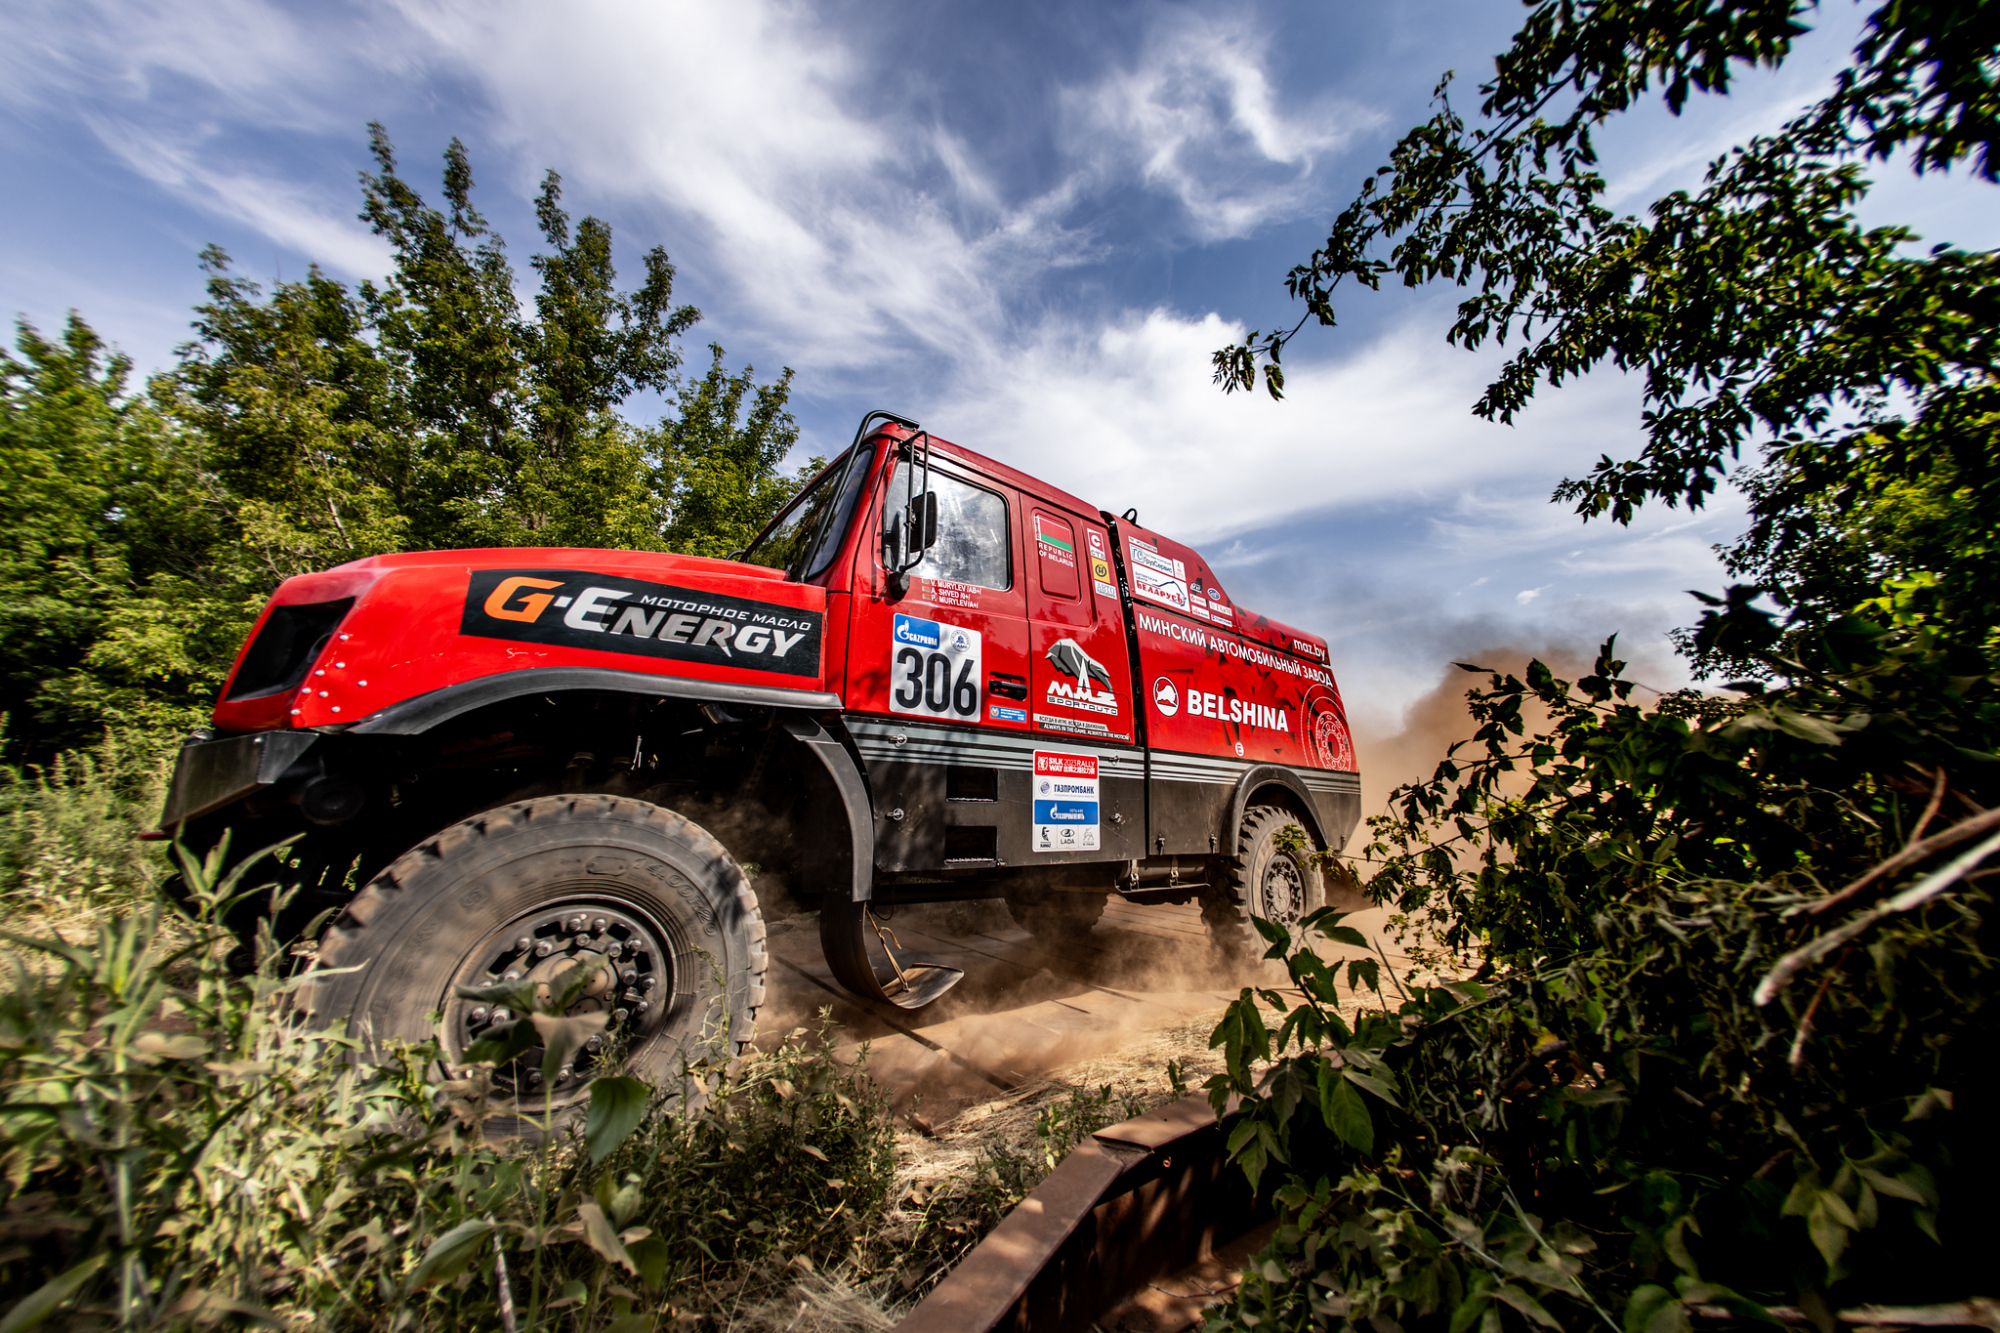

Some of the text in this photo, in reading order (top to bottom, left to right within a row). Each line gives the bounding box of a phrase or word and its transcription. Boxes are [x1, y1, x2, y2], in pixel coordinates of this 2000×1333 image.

[1038, 542, 1073, 560] REPUBLIC
[1039, 550, 1074, 568] OF BELARUS
[937, 580, 966, 592] MURYLEV
[938, 588, 959, 599] SHVED
[939, 596, 967, 607] MURYLEV
[640, 594, 812, 632] МОТОРНОЕ МАСЛО
[1138, 613, 1334, 688] МИНСКИЙ АВТОМОБИЛЬНЫЙ ЗАВОД
[1294, 639, 1325, 660] maz.by
[895, 647, 977, 717] 306
[1187, 688, 1289, 732] BELSHINA
[1049, 757, 1063, 765] SILK
[1077, 759, 1095, 768] RALLY
[1049, 764, 1063, 772] WAY
[1054, 784, 1095, 794] ГАЗПРОМБАНК
